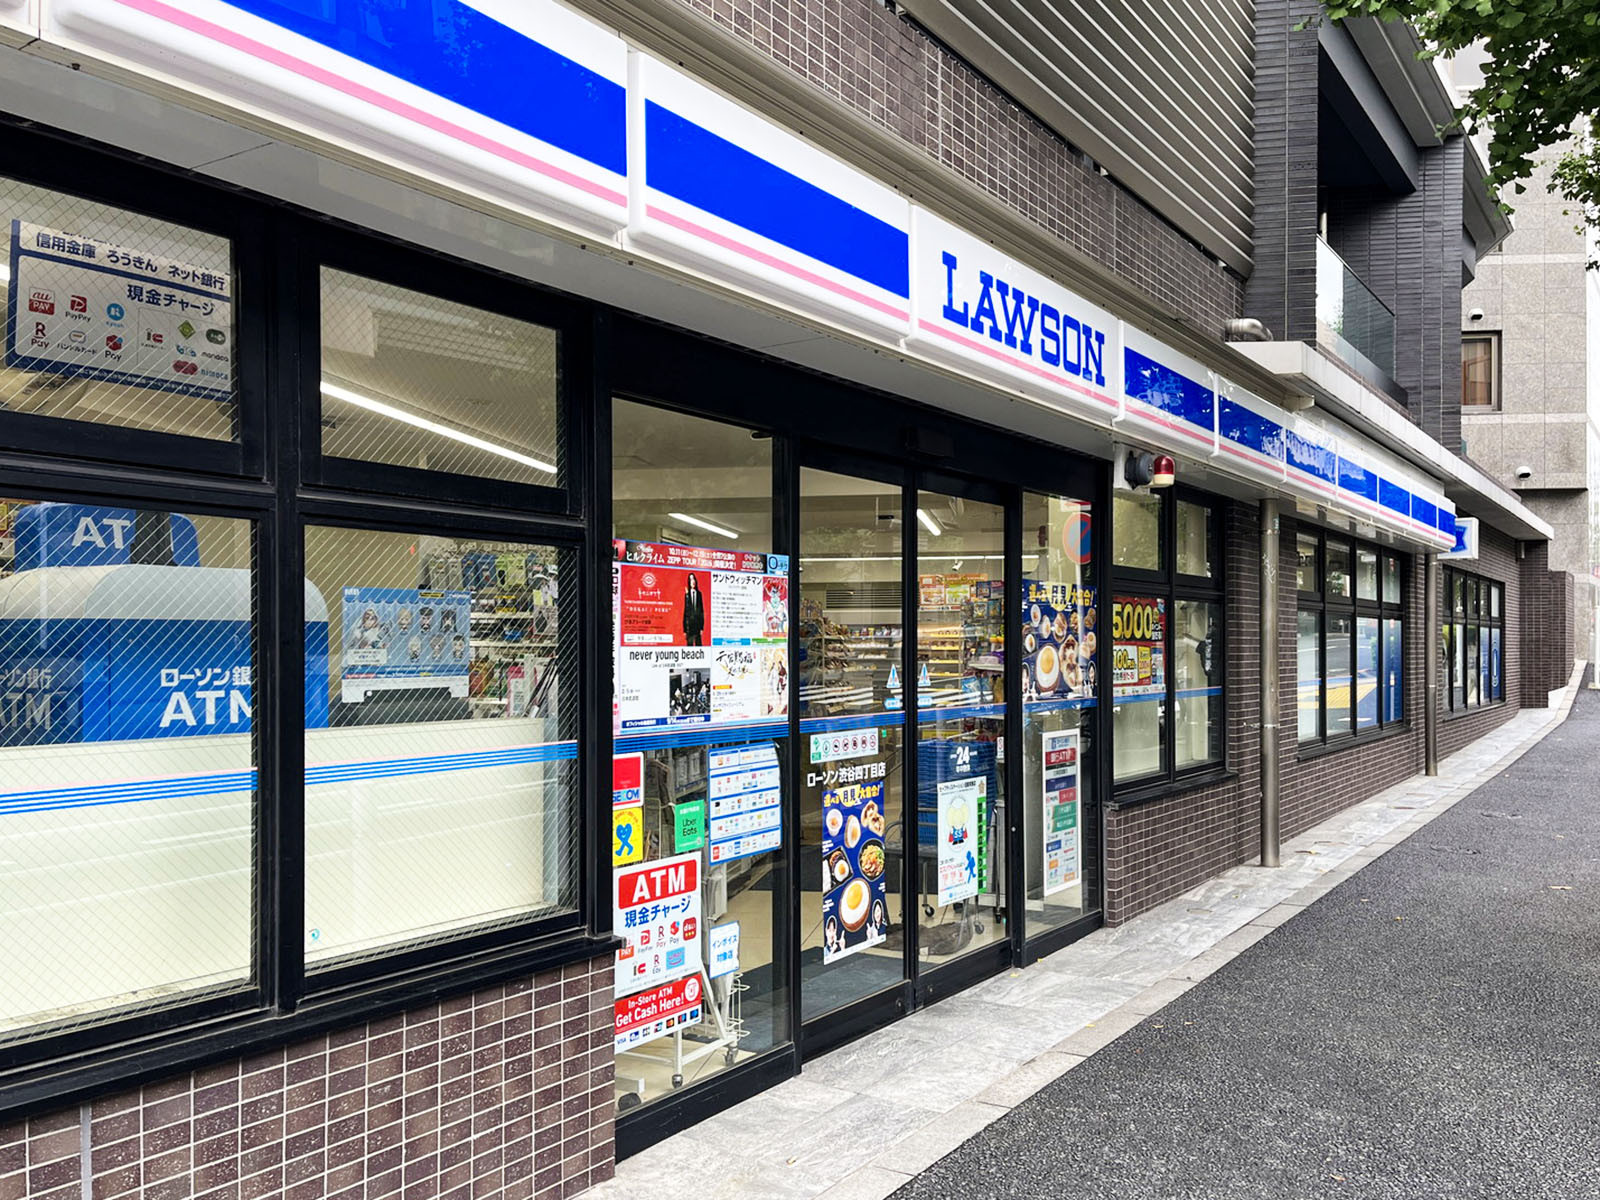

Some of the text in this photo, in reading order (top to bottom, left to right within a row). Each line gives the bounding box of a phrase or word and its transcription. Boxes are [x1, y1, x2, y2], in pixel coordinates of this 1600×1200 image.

[36, 232, 96, 259] 信用金庫
[107, 250, 158, 273] ろうきん
[168, 265, 225, 291] ネット銀行
[127, 284, 215, 316] 現金チャージ
[942, 250, 1105, 388] LAWSON
[712, 573, 762, 585] サンドウィッチマン
[629, 648, 705, 662] never young beach
[956, 746, 970, 764] 24
[807, 762, 886, 787] ローソン渋谷四丁目店
[682, 818, 697, 828] Uber
[682, 828, 698, 837] Eats
[632, 865, 686, 904] ATM
[624, 895, 692, 928] 現金チャージ
[615, 992, 685, 1028] Get Cash Here!
[628, 986, 673, 1009] In-Store ATM
